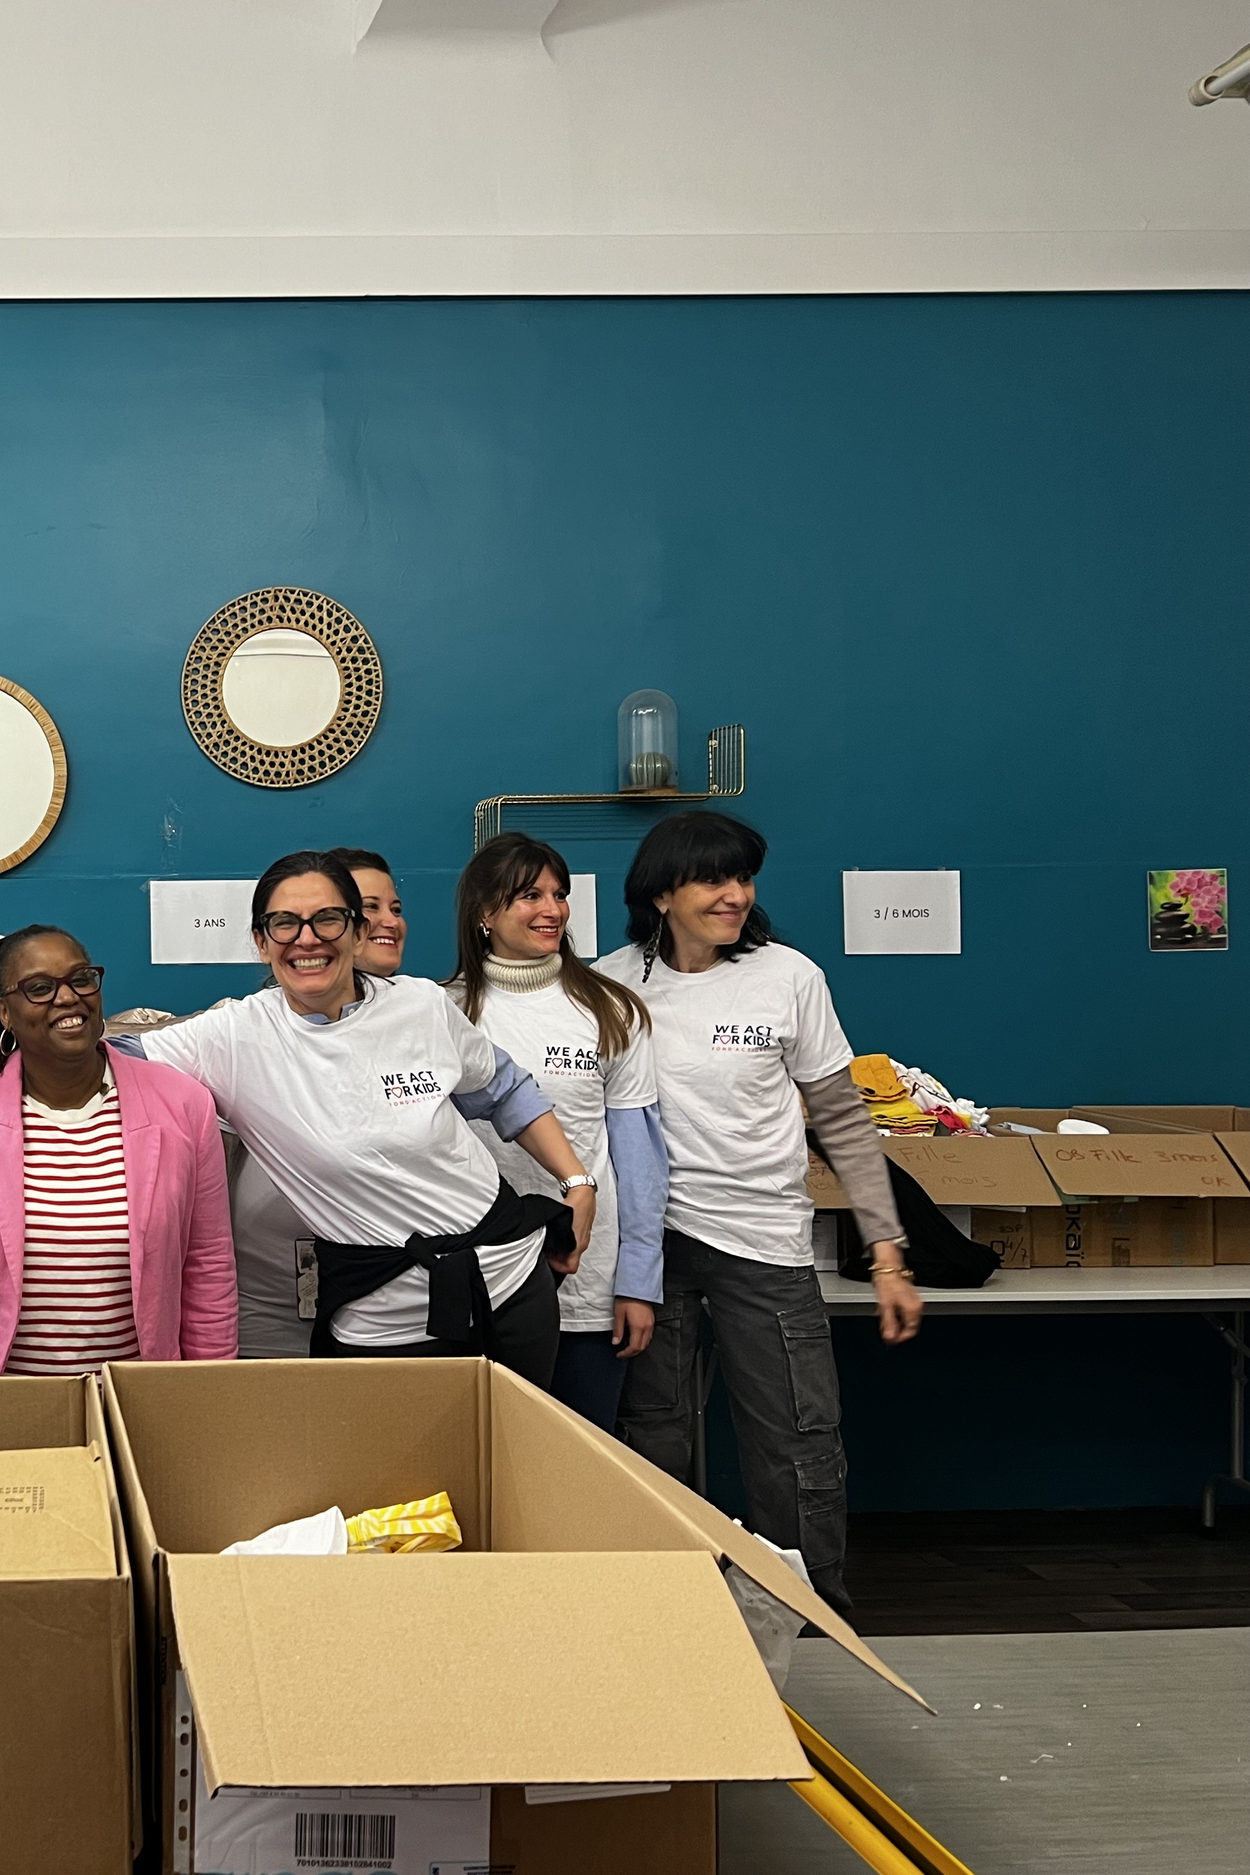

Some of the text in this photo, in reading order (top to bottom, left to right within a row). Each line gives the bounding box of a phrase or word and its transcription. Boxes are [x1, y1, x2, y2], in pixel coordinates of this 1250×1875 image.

[874, 906, 930, 920] 3 / 6 MOIS
[194, 918, 226, 928] 3 ANS
[715, 1024, 773, 1037] WE ACT
[743, 1035, 771, 1048] KIDS
[546, 1046, 600, 1062] WE ACT
[380, 1071, 434, 1086] WE ACT
[413, 1082, 442, 1095] KIDS
[897, 1145, 962, 1164] Fille
[941, 1176, 997, 1188] mois
[1201, 1176, 1230, 1186] OK
